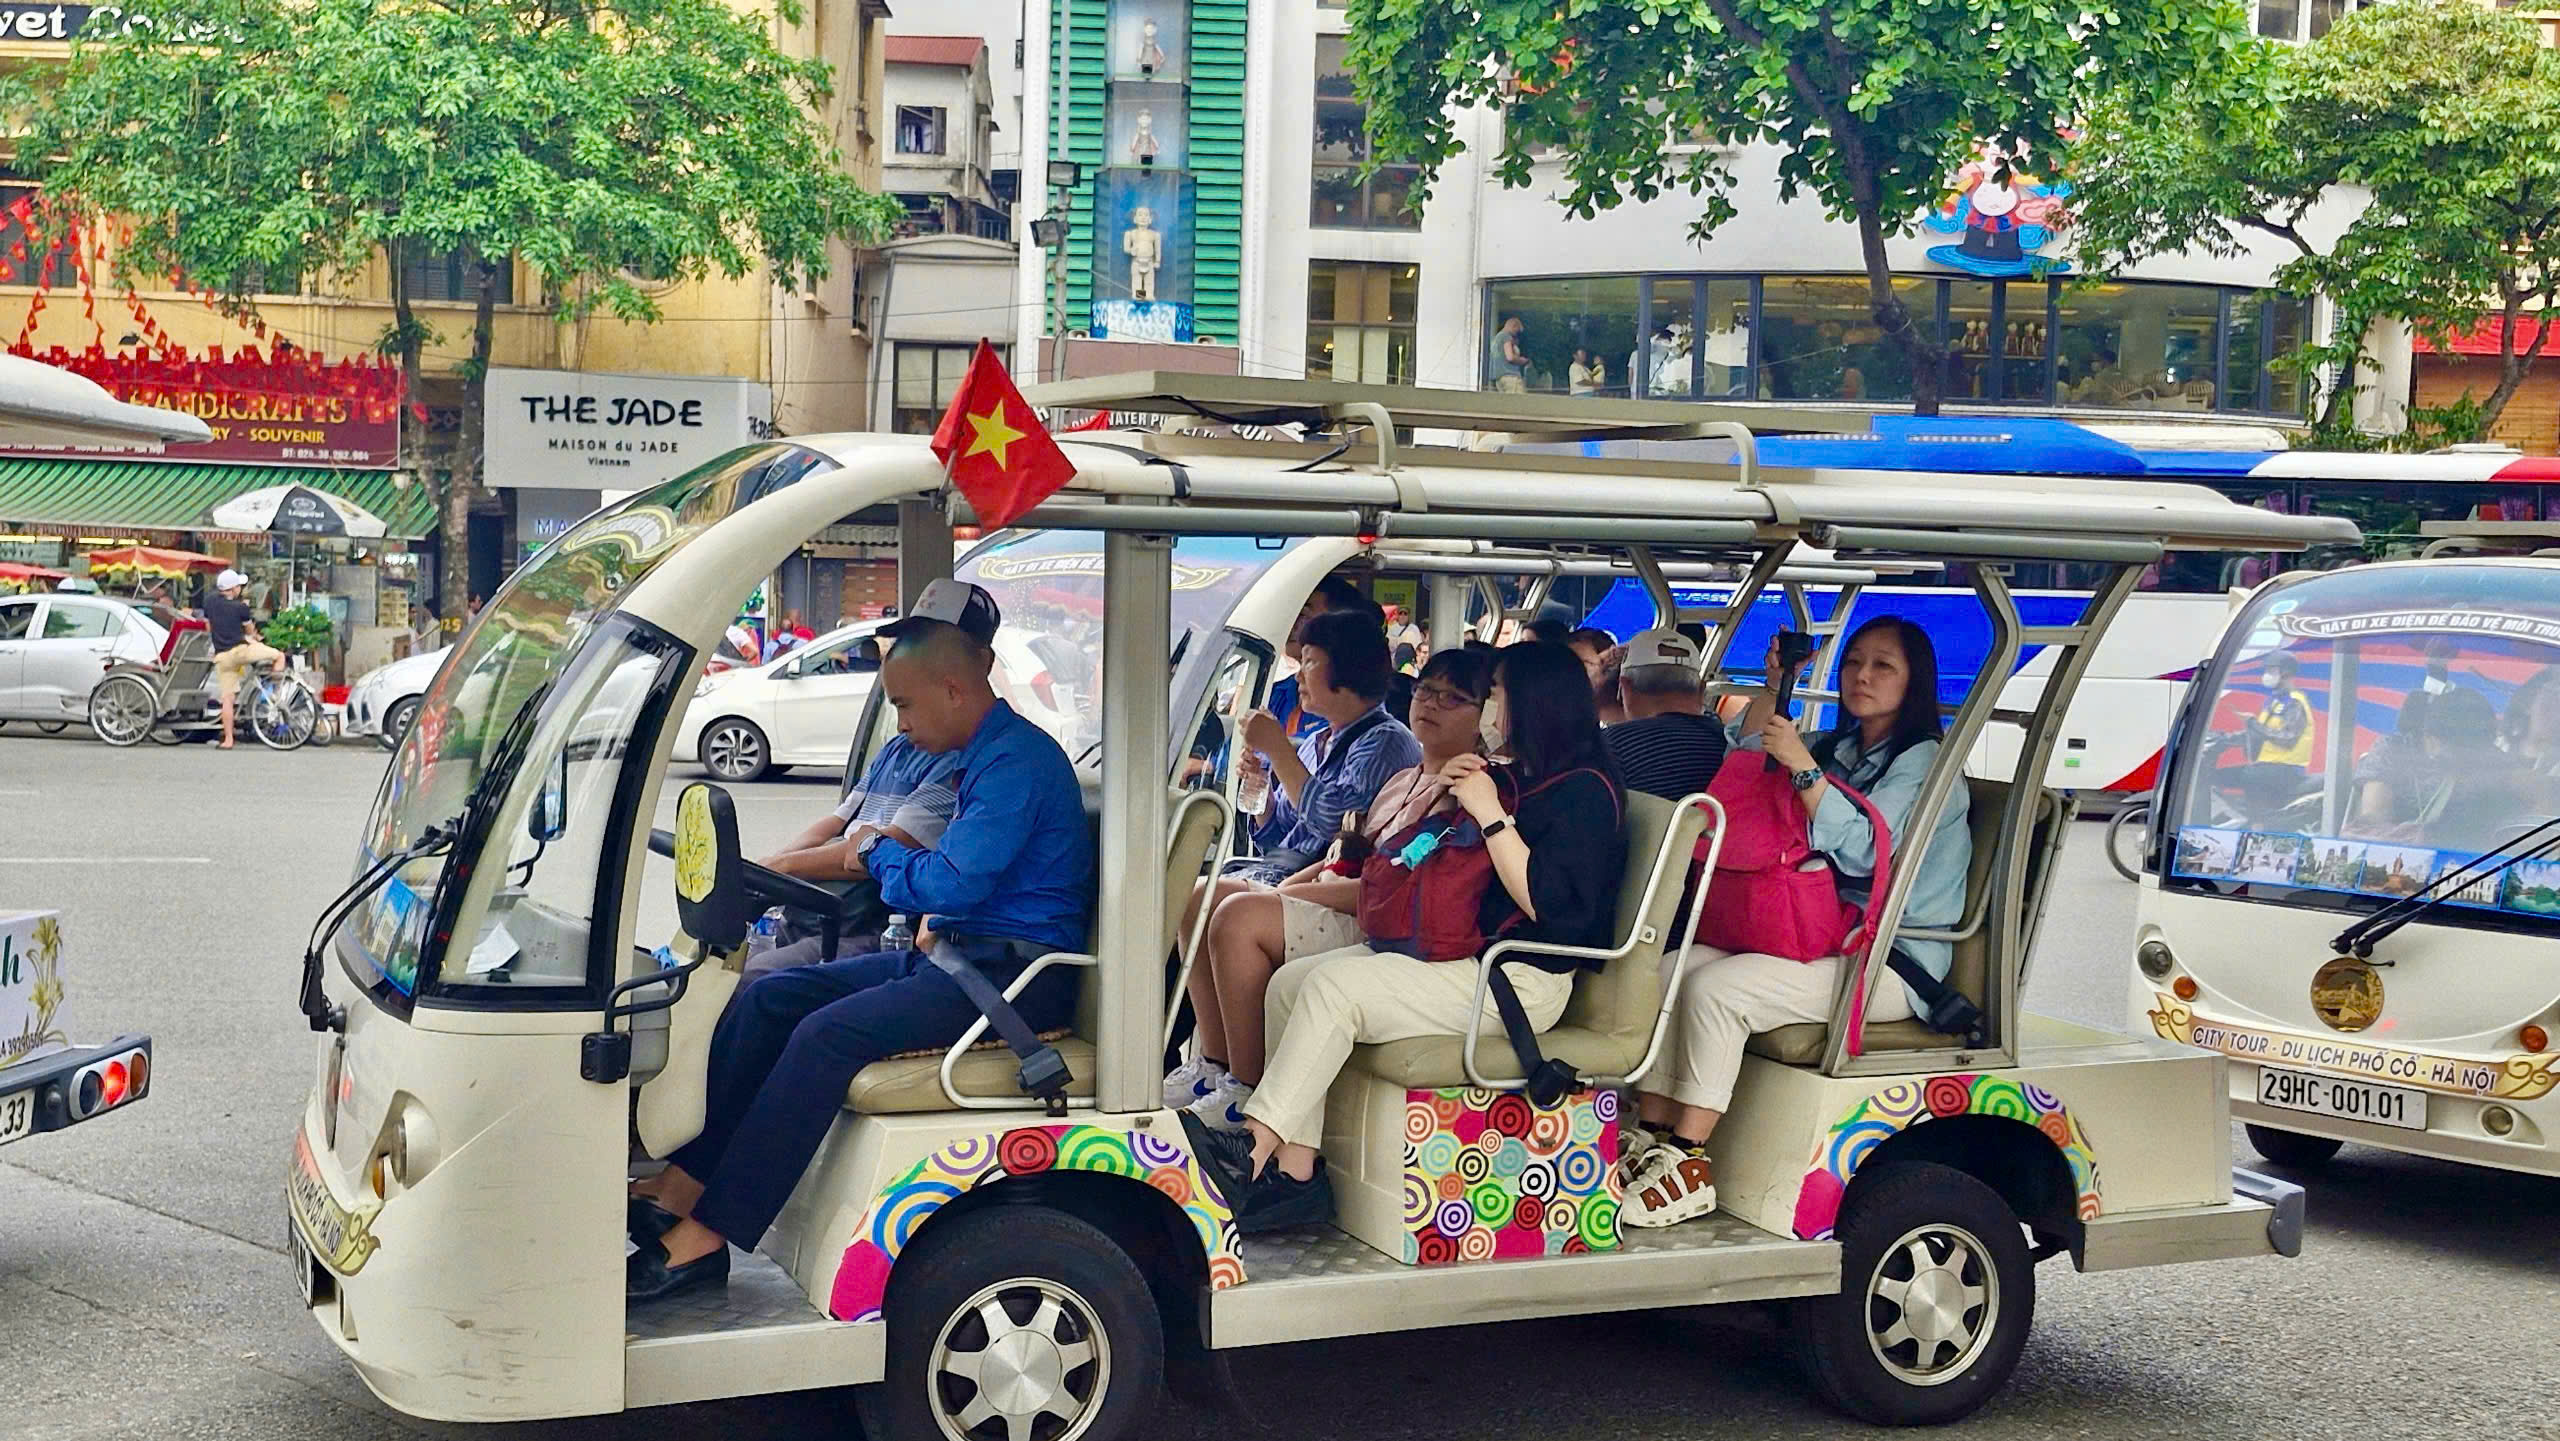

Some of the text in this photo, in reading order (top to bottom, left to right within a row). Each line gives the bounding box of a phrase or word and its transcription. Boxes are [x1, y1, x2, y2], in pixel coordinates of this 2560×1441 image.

[520, 394, 703, 427] THE JADE
[250, 428, 326, 444] SOUVENIR
[548, 439, 679, 453] MAISON du JADE
[588, 457, 631, 467] Vietnam
[2369, 616, 2389, 628] XE
[2192, 1027, 2226, 1046] CITY
[2229, 1032, 2270, 1054] TOUR
[2280, 1040, 2304, 1059] DU
[2307, 1045, 2345, 1068] LỊCH
[2349, 1050, 2389, 1073] PHỐ
[2390, 1054, 2421, 1078] CỔ
[2431, 1062, 2456, 1085] HÀ
[2461, 1066, 2497, 1095] NỘI
[2264, 1073, 2404, 1122] 29HC-001.01
[0, 1096, 26, 1137] .33
